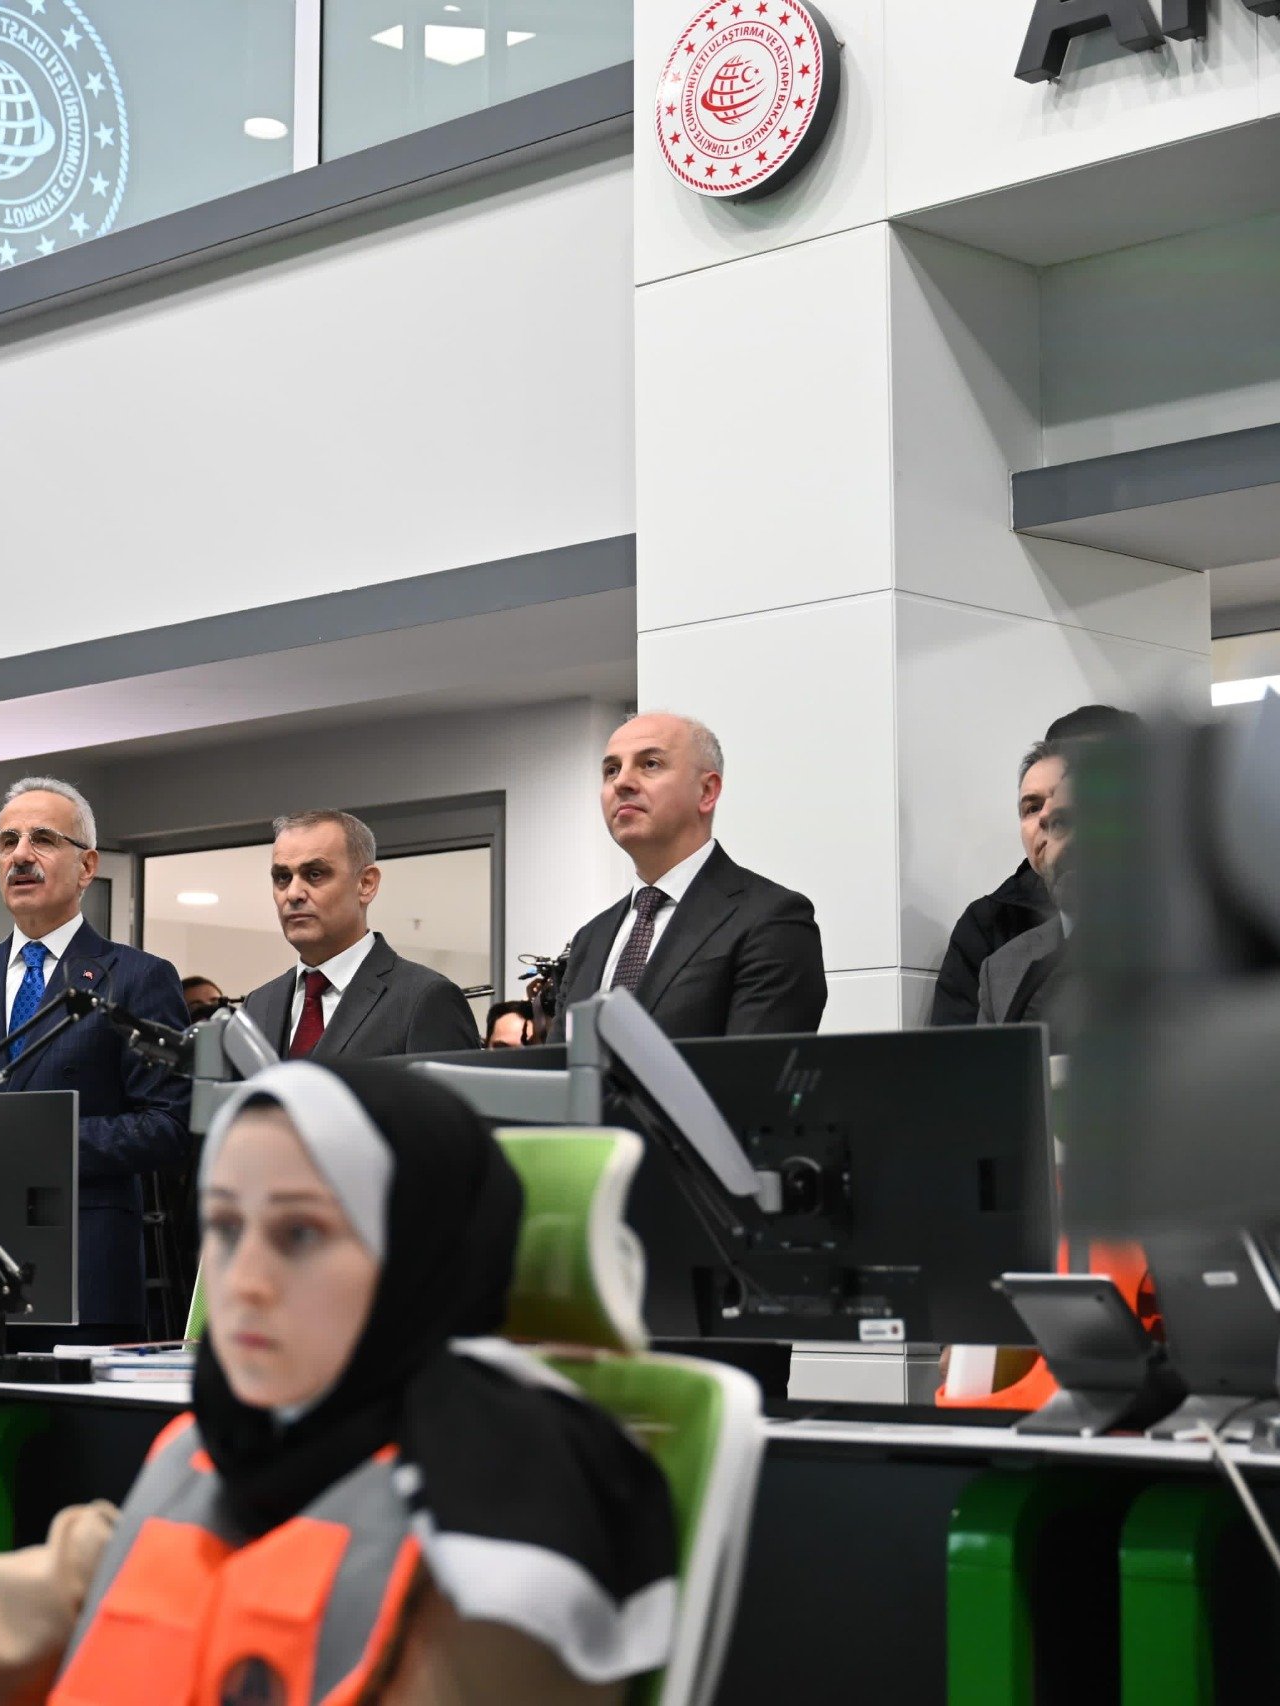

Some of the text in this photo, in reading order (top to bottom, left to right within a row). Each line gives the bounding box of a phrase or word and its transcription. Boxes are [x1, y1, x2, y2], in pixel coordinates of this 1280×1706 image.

[709, 26, 764, 53] ULAŞTIRMA
[766, 32, 778, 47] VE
[774, 45, 790, 91] ALTYAPI
[741, 94, 786, 150] BAKANLIĞI
[693, 130, 730, 156] TÜRKİYE
